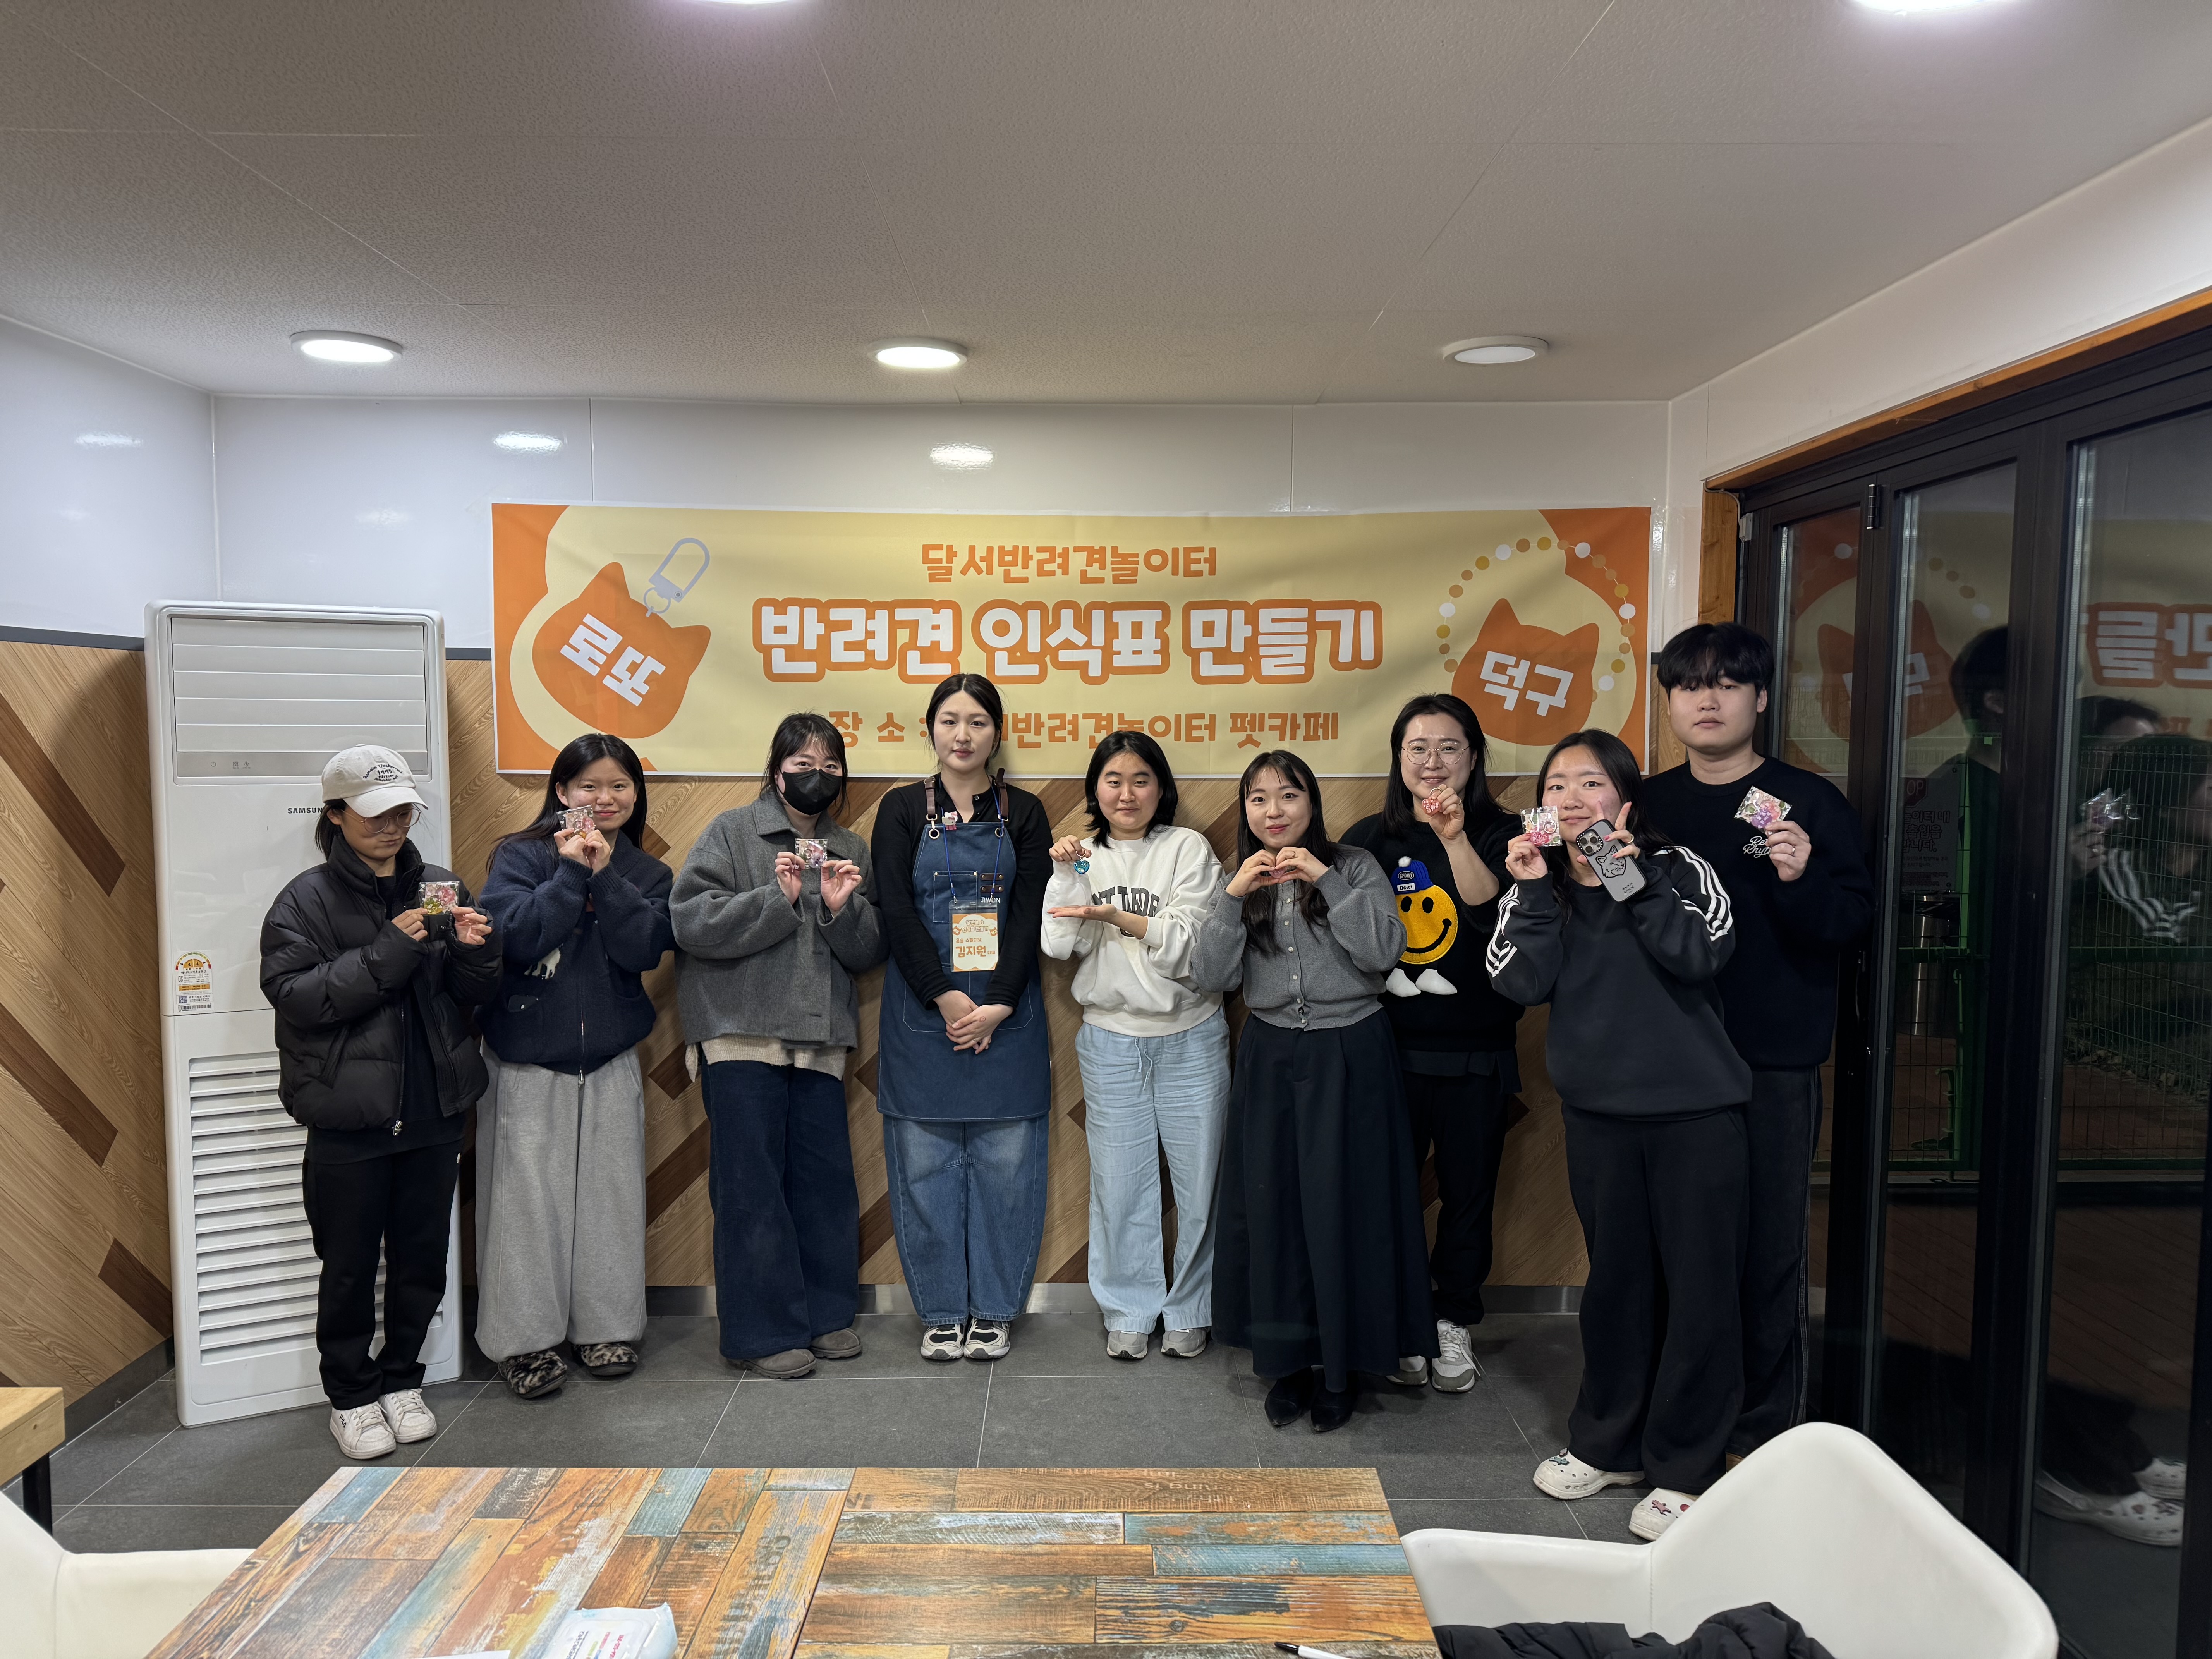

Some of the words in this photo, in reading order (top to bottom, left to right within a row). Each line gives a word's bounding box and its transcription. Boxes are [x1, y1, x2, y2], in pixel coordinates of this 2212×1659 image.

[922, 543, 1217, 584] 달서반려견놀이터
[560, 613, 666, 706] 로또
[758, 603, 956, 678] 반려견
[977, 604, 1164, 681] 인식표
[1188, 604, 1377, 679] 만들기
[1480, 651, 1573, 716] 덕구
[829, 711, 863, 748] 장
[877, 712, 905, 742] 소
[1230, 712, 1339, 749] 펫카페
[1906, 780, 1924, 795] OP
[1750, 836, 1768, 846] Re
[955, 945, 986, 958] 김지원
